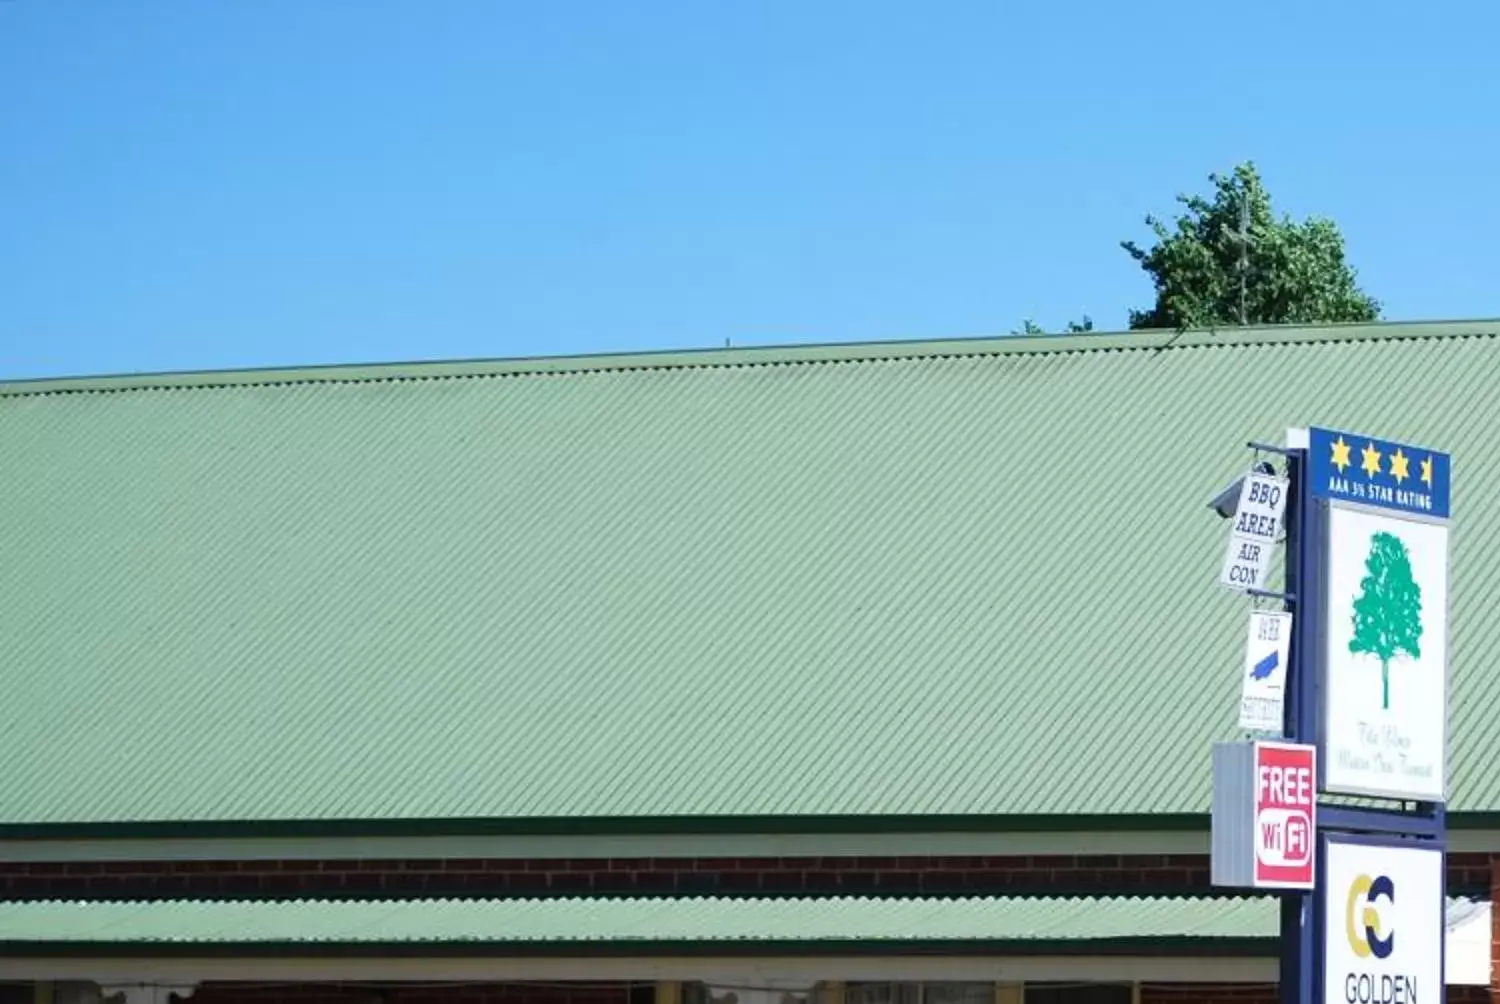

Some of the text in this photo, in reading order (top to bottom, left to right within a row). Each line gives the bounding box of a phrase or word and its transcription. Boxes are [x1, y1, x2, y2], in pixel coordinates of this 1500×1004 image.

[1248, 481, 1280, 510] BBQ
[1328, 476, 1349, 493] AAA
[1368, 483, 1393, 503] STAR
[1396, 489, 1432, 510] RATING
[1235, 511, 1276, 537] AREA
[1238, 543, 1260, 562] AIR
[1229, 565, 1259, 584] CON
[1259, 765, 1310, 805] FREE
